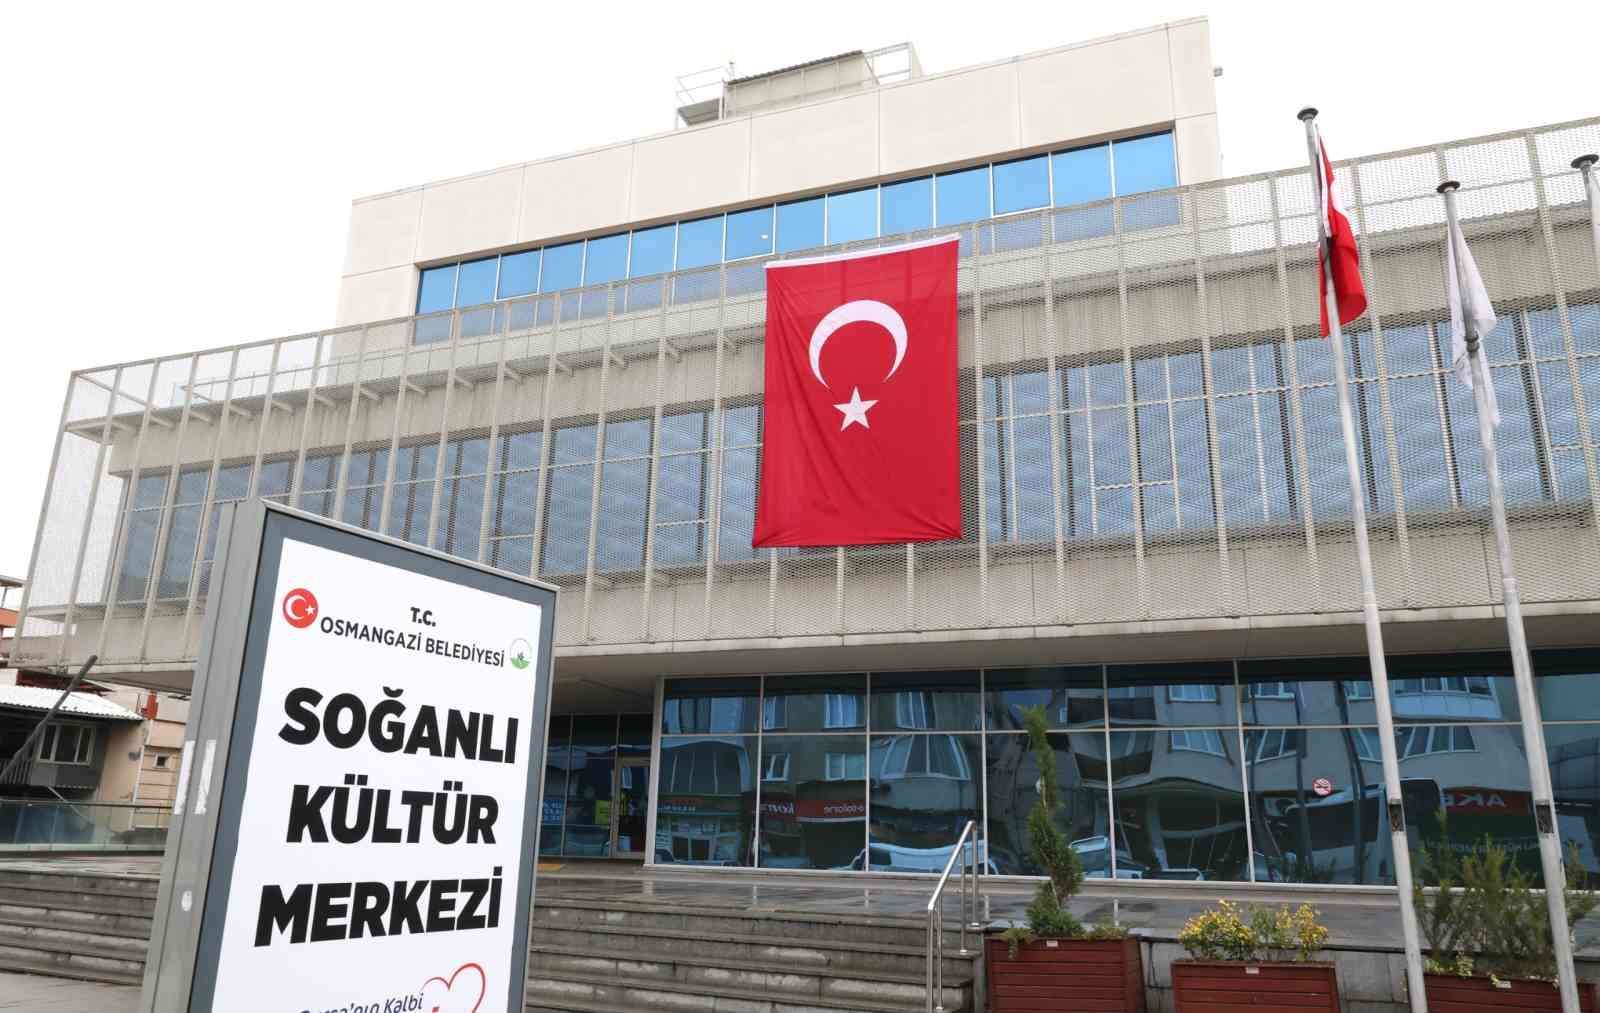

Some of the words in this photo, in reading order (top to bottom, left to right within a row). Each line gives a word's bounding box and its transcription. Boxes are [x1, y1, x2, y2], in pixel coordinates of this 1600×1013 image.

[321, 616, 422, 651] OSMANGAZİ
[425, 637, 505, 667] BELEDİYESİ
[411, 607, 436, 627] T.C.
[278, 686, 519, 764] SOĞANLI
[286, 773, 499, 844] KÜLTÜR
[254, 866, 502, 947] MERKEZİ
[384, 992, 424, 1013] Kalbi
